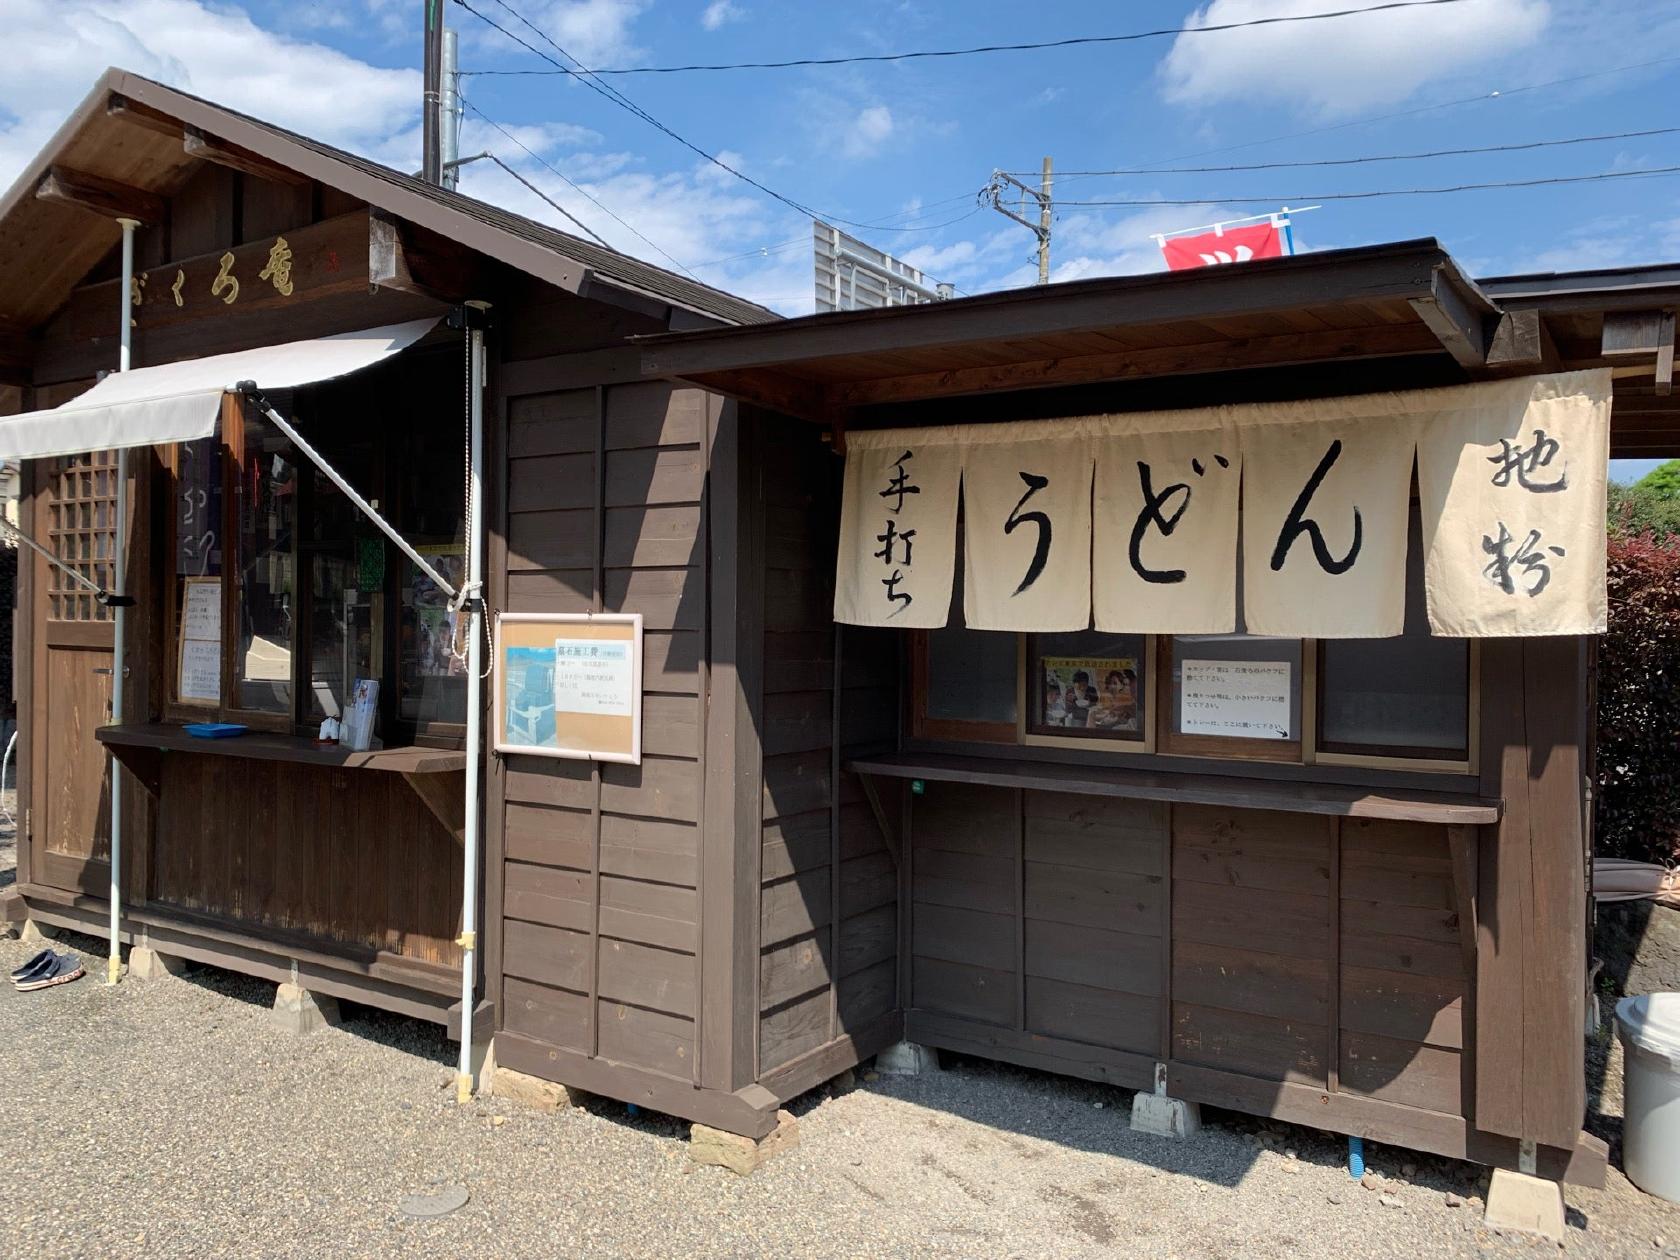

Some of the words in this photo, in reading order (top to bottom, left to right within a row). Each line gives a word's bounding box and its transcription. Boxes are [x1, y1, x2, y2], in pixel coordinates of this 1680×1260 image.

[874, 450, 921, 619] 手打ち
[1004, 439, 1362, 598] うどん
[1481, 429, 1570, 598] 地粉
